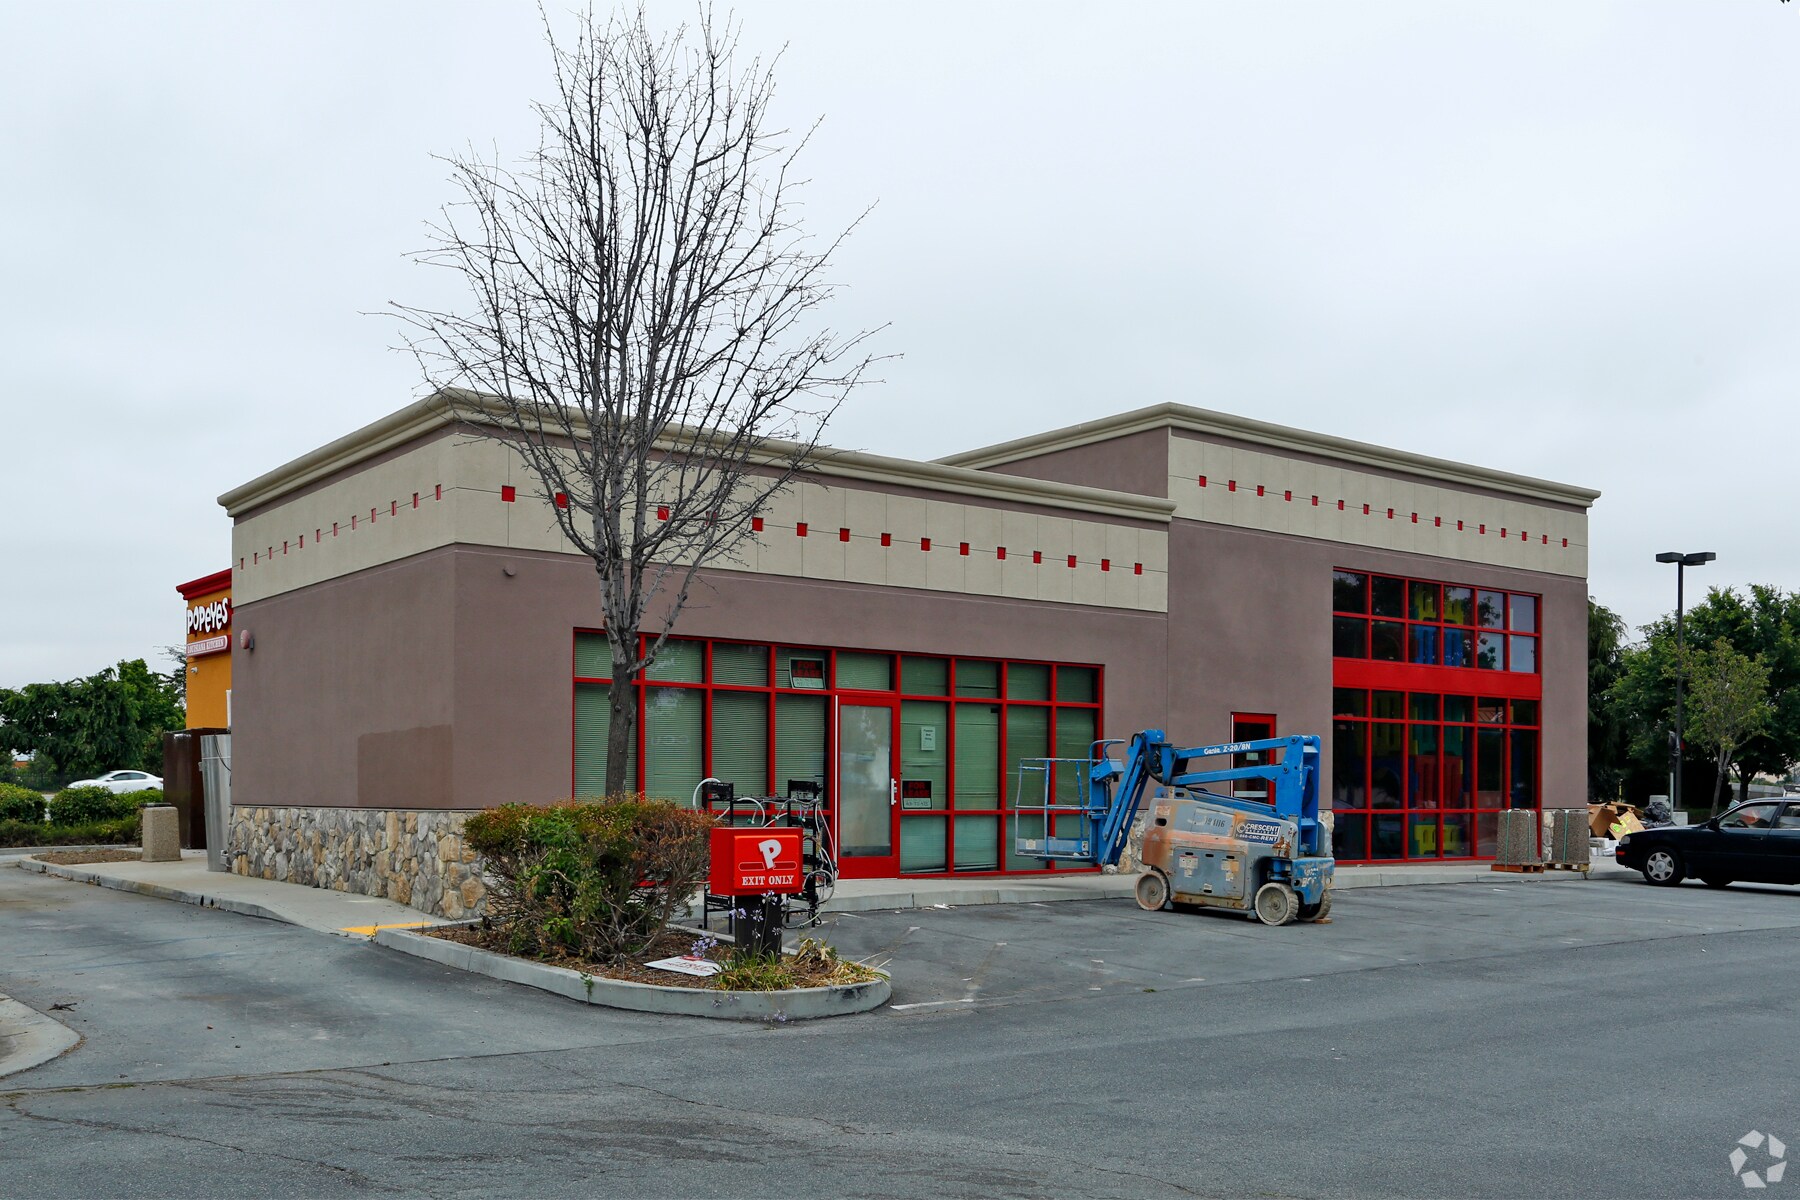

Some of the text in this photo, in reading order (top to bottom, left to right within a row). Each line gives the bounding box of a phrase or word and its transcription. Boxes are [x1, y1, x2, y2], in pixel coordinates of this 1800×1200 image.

[1245, 823, 1279, 832] CRESCENT
[757, 838, 782, 870] P
[742, 874, 794, 886] EXIT ONLY
